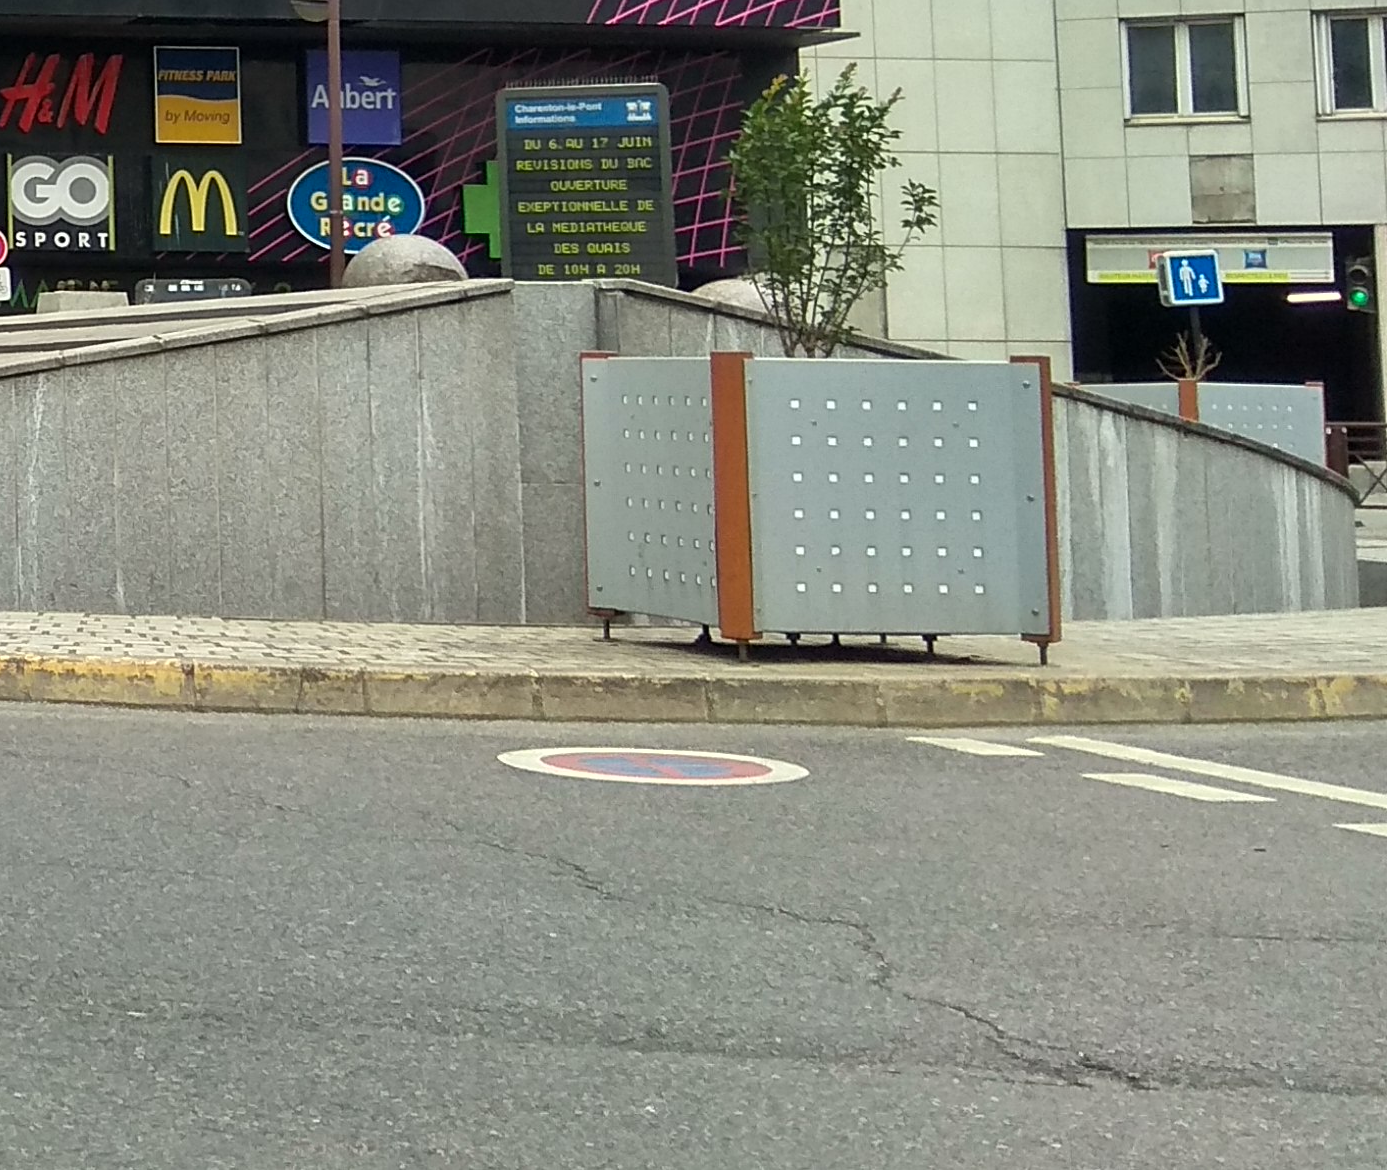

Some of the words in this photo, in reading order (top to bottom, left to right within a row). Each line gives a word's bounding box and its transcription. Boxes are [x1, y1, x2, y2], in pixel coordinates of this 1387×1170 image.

[158, 70, 204, 82] FITNESS
[206, 70, 236, 82] PARK
[165, 110, 180, 124] by
[184, 110, 231, 125] Moving
[514, 115, 576, 124] Informations
[524, 139, 541, 150] DU
[592, 137, 608, 148] 17
[617, 136, 652, 148] JUIN
[516, 159, 593, 171] REVISIONS
[601, 158, 618, 170] DU
[342, 167, 369, 186] La
[11, 161, 110, 220] GO
[550, 180, 628, 192] OUVERTURE
[310, 191, 402, 213] Gande
[517, 201, 629, 213] EXEPTIONNELLE
[637, 200, 654, 211] DE
[527, 222, 544, 234] LA
[552, 221, 647, 233] MEDIATHEQUE
[15, 231, 109, 248] SPORT
[554, 243, 579, 254] DES
[587, 242, 631, 254] QUAIS
[538, 264, 555, 275] DE
[564, 264, 589, 275] 10H
[597, 264, 606, 275] A
[614, 264, 641, 275] 20H
